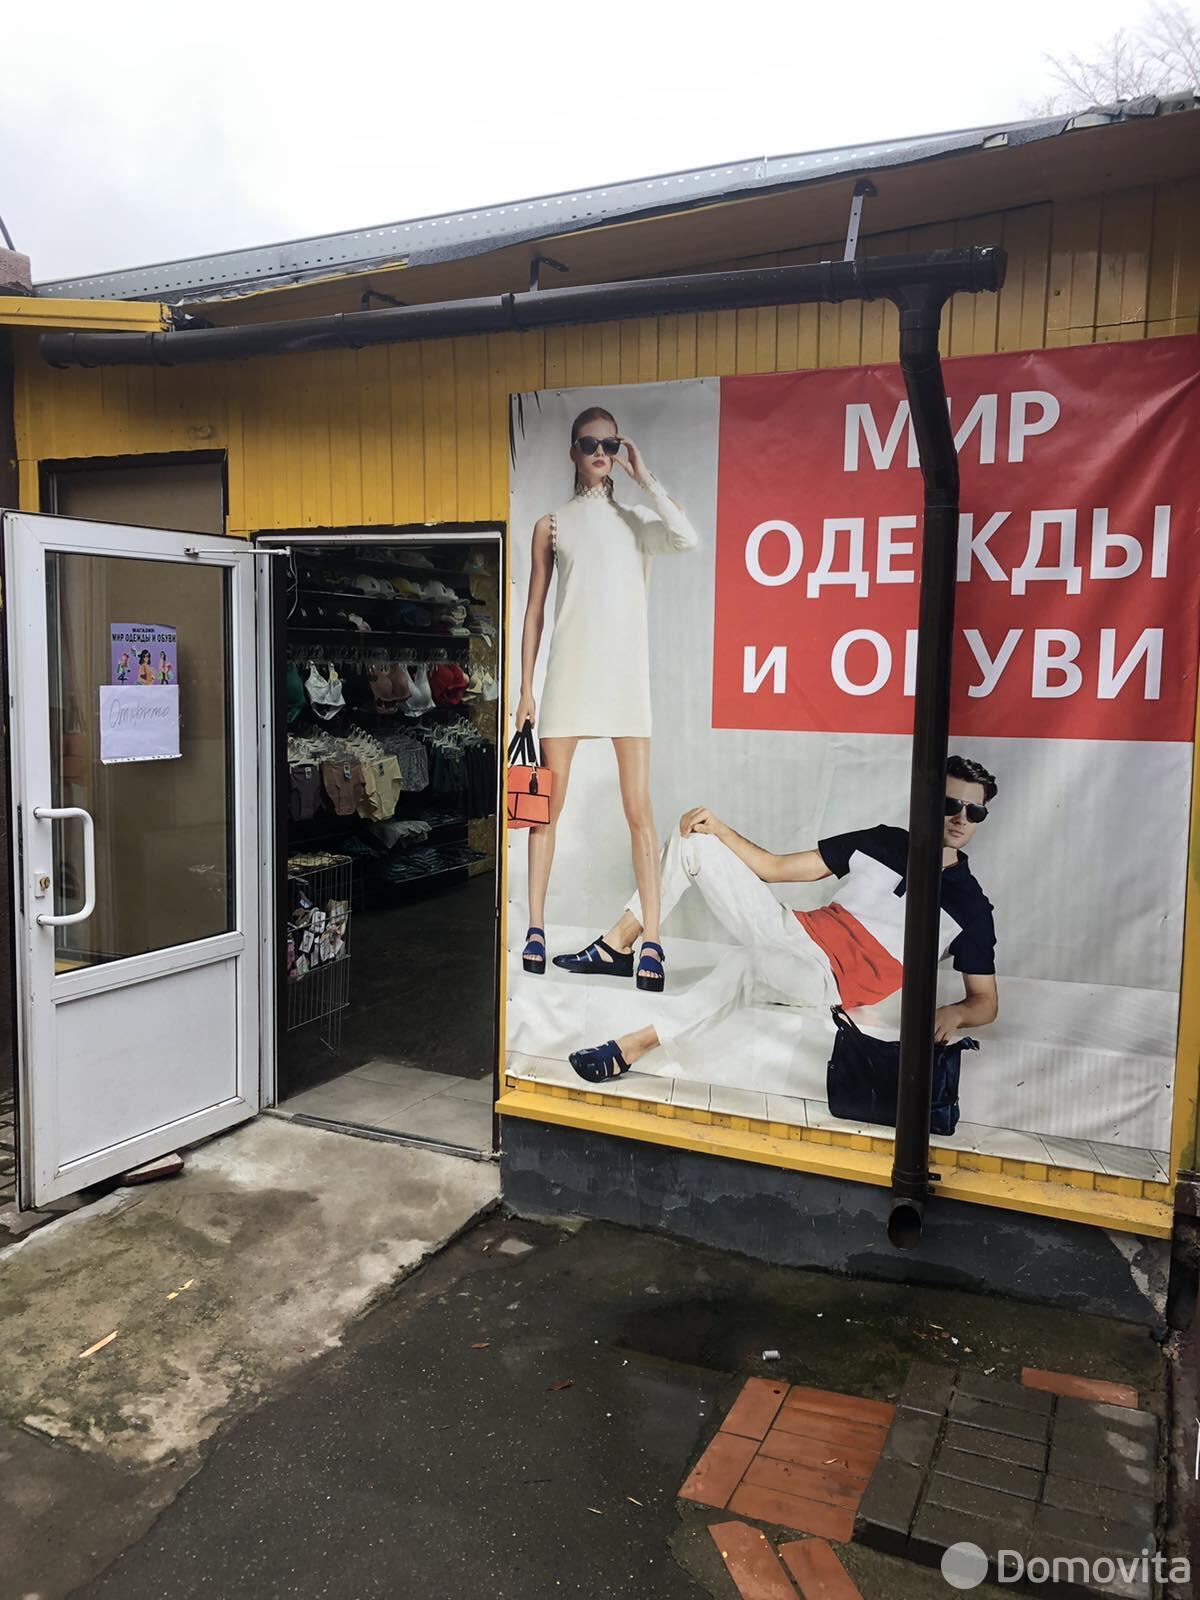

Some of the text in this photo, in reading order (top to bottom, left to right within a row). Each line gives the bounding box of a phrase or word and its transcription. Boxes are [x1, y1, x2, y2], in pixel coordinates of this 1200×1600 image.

[844, 390, 1060, 472] МИР
[112, 633, 124, 642] МИР
[125, 633, 151, 643] ОДЕЖДЫ
[157, 633, 176, 643] ОБУВИ
[743, 646, 787, 694] и
